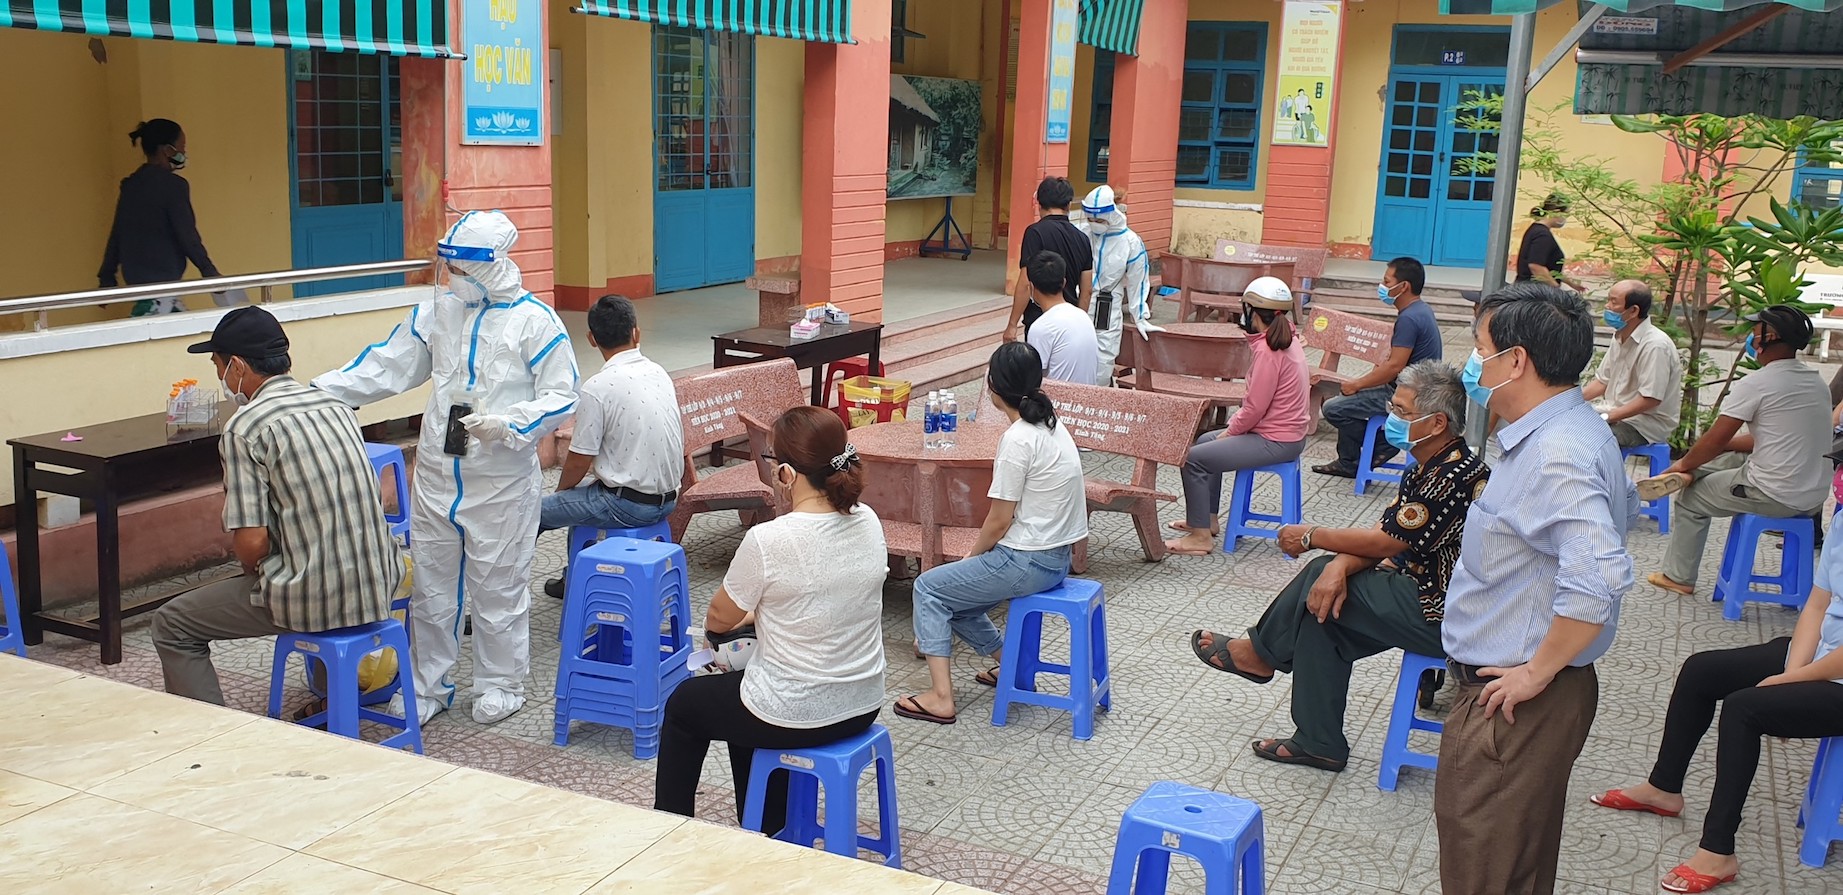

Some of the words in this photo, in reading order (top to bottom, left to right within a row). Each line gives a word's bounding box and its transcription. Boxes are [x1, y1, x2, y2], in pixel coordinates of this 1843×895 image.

[474, 44, 502, 93] HỌC
[1077, 418, 1092, 429] HỌC
[1092, 421, 1109, 431] 2020
[1114, 425, 1130, 434] 2021
